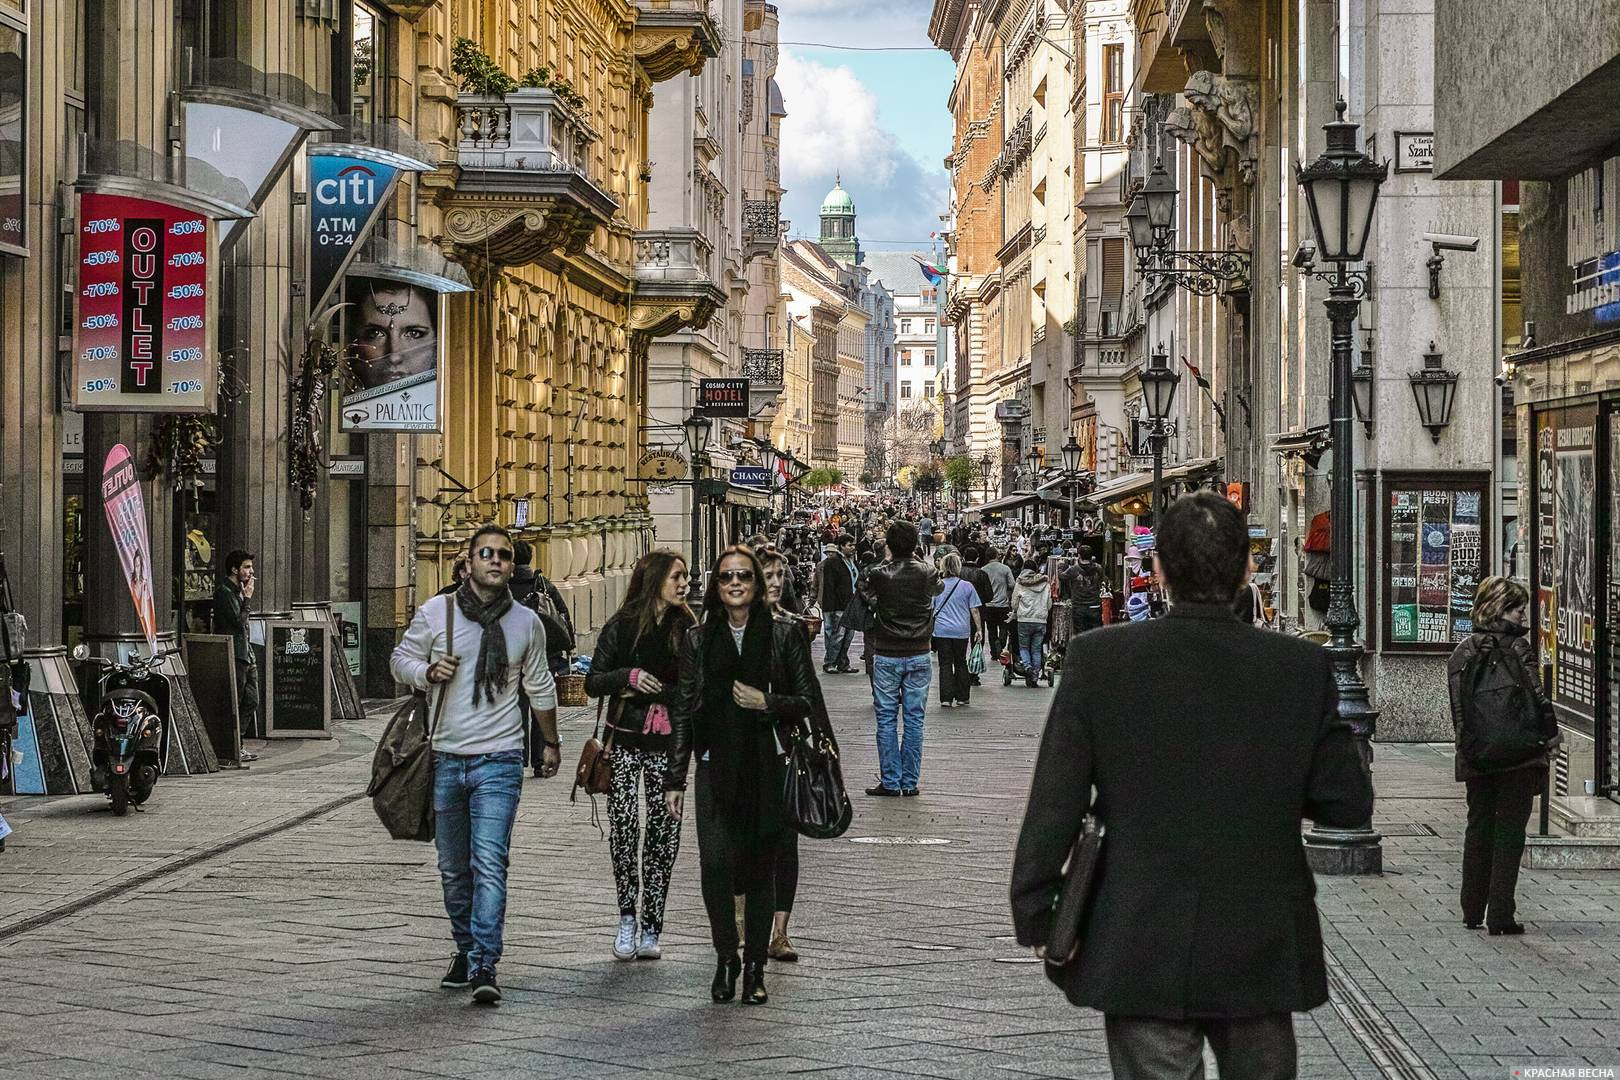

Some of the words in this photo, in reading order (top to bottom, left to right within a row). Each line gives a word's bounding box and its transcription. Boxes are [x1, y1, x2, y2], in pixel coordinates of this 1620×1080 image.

[315, 172, 374, 205] citi
[84, 218, 119, 233] -70%
[169, 220, 204, 235] -50%
[316, 217, 356, 232] ATM
[319, 234, 354, 246] 0-24
[84, 250, 119, 265] -50%
[168, 252, 204, 267] -70%
[83, 282, 118, 297] -70%
[168, 284, 204, 299] -50%
[131, 227, 157, 386] OUTLET
[82, 314, 118, 329] -50%
[167, 316, 203, 330] -70%
[82, 346, 117, 361] -70%
[167, 347, 202, 362] -50%
[82, 379, 116, 392] -50%
[167, 380, 201, 394] -70%
[705, 389, 744, 401] HOTEL
[376, 402, 434, 421] PALANTIC
[640, 451, 685, 466] RESTAURANT
